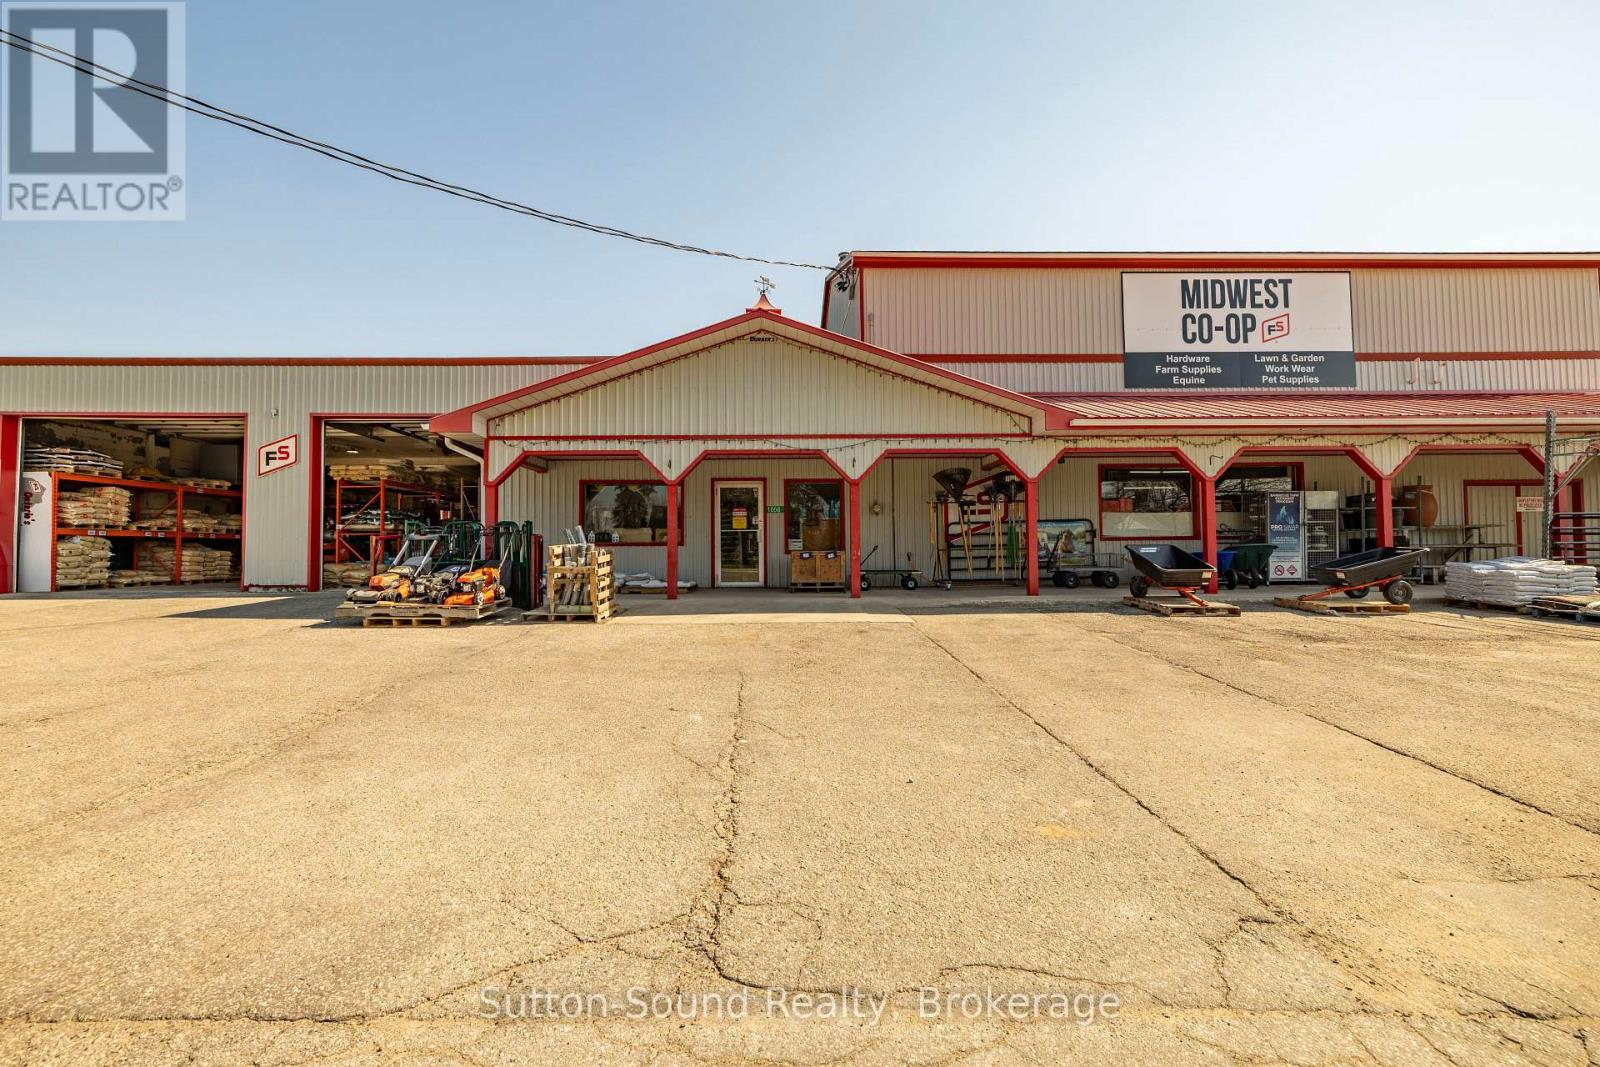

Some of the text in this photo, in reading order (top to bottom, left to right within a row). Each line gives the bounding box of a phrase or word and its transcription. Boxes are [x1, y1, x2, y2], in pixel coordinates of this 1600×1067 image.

[1181, 279, 1292, 309] MIDWEST
[1182, 313, 1284, 344] CO-OP FS
[1166, 354, 1211, 363] Hardware
[1254, 353, 1325, 362] Lawn & Garden
[1155, 365, 1222, 375] Farm Supplies
[1265, 364, 1316, 373] Work Wear
[1173, 376, 1206, 386] Equine
[1262, 375, 1320, 385] Pet Supplies
[265, 445, 290, 466] FS
